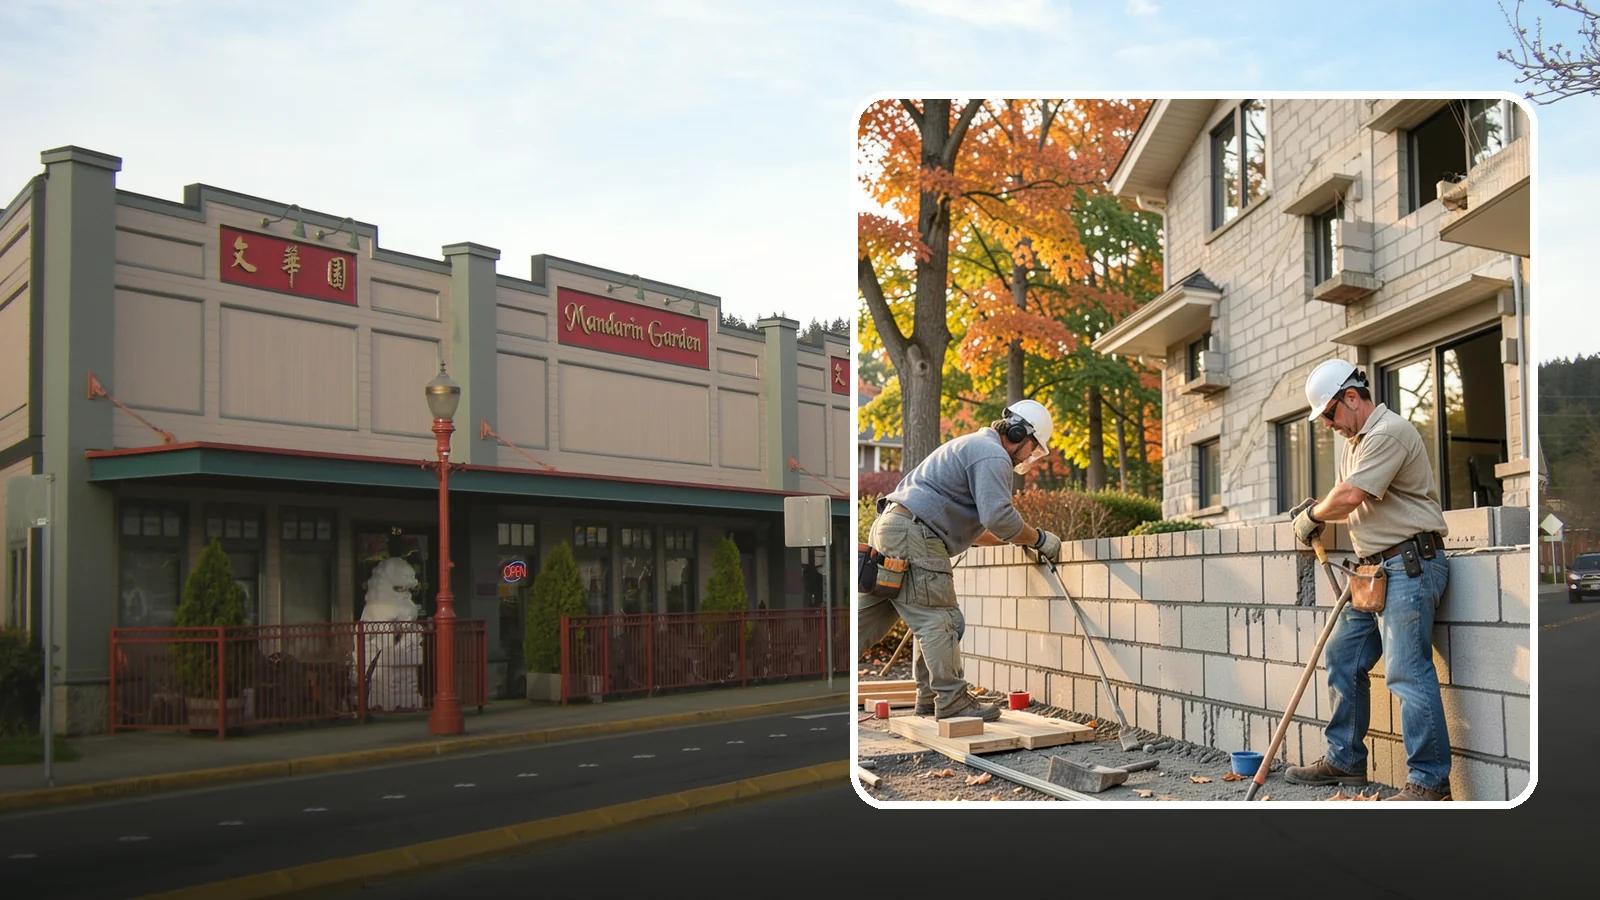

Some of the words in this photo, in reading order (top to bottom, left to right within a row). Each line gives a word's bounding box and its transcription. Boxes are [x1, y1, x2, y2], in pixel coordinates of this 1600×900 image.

[231, 235, 346, 290] 文華園
[564, 302, 644, 341] Mandarin
[648, 320, 701, 352] Garden
[503, 565, 527, 578] OPEN
